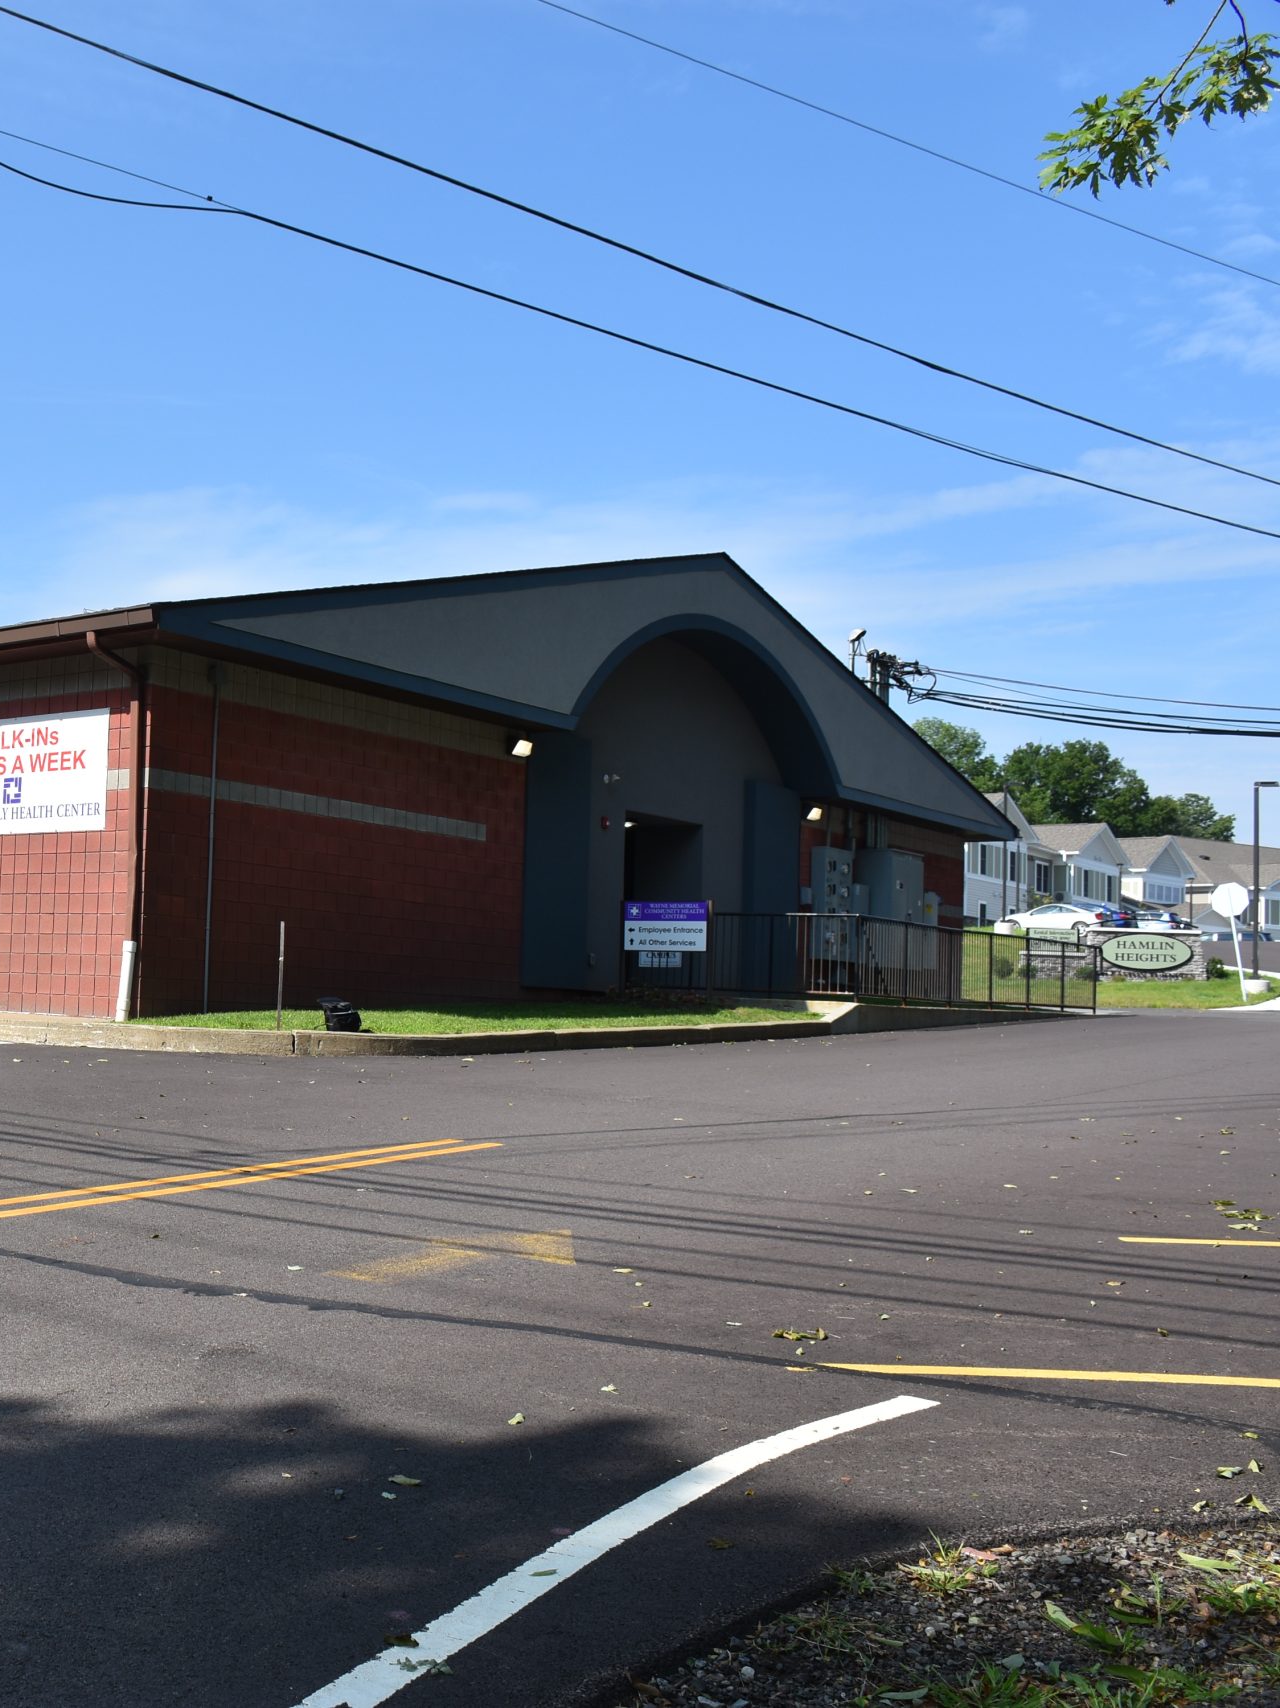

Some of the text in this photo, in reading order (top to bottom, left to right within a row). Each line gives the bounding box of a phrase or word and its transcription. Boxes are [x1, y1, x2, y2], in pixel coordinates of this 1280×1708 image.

[11, 755, 24, 774] A
[29, 749, 87, 773] WEEK
[11, 804, 53, 820] HEALTH
[56, 802, 101, 818] CENTER
[638, 926, 671, 934] Employee
[1116, 940, 1175, 950] HAMLIN
[1115, 952, 1177, 963] HEIGHTS
